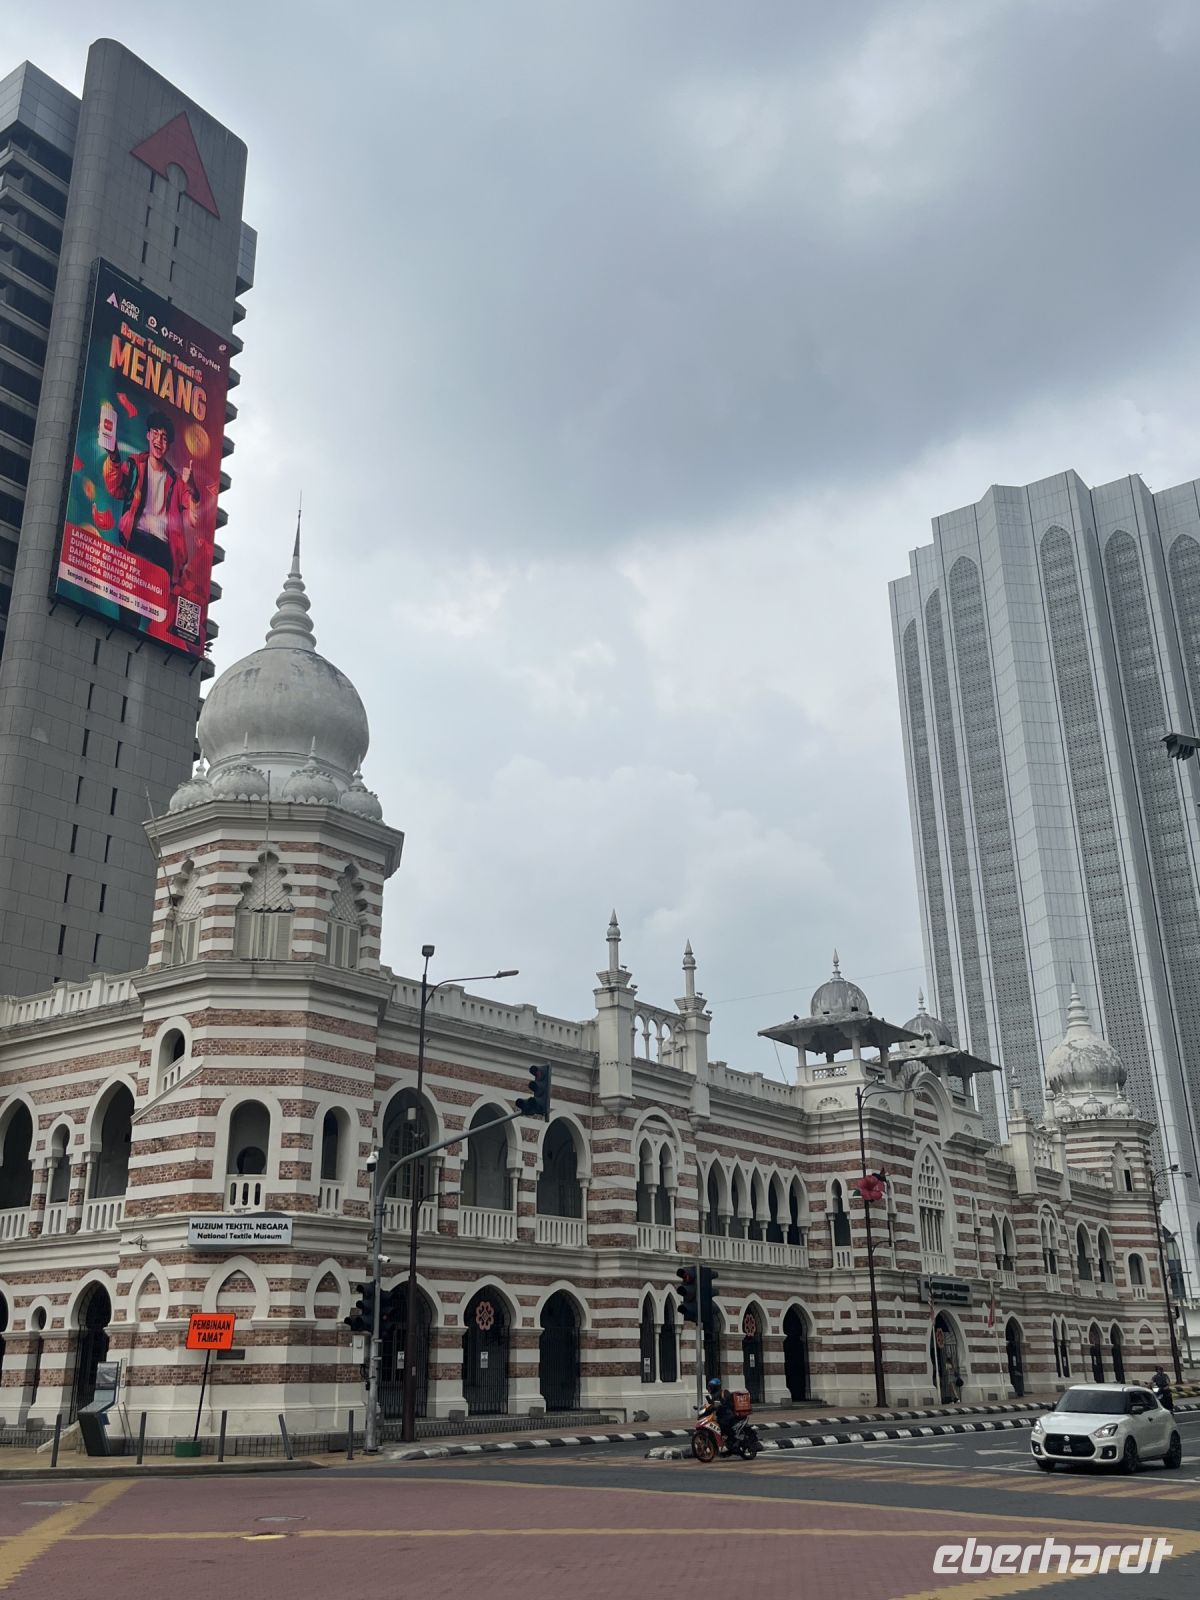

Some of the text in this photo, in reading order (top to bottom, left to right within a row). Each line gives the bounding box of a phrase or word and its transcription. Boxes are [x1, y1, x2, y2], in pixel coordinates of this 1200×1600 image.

[120, 305, 138, 321] BANK
[121, 299, 140, 314] AGRO
[121, 321, 146, 346] Bayar
[168, 331, 184, 346] FPX
[198, 352, 220, 372] PayNet
[109, 333, 207, 422] MENANG
[71, 528, 137, 564] LAKUKAN TRANSAKSI
[68, 554, 101, 576] SEHINGGA
[70, 537, 101, 556] DUITNOW
[112, 558, 128, 570] ATAU
[129, 565, 141, 577] FPX
[69, 546, 162, 596] DAN BERPELUANG MEMENANGI
[192, 1320, 231, 1330] PEMBINAAN
[198, 1332, 224, 1342] TAMAT
